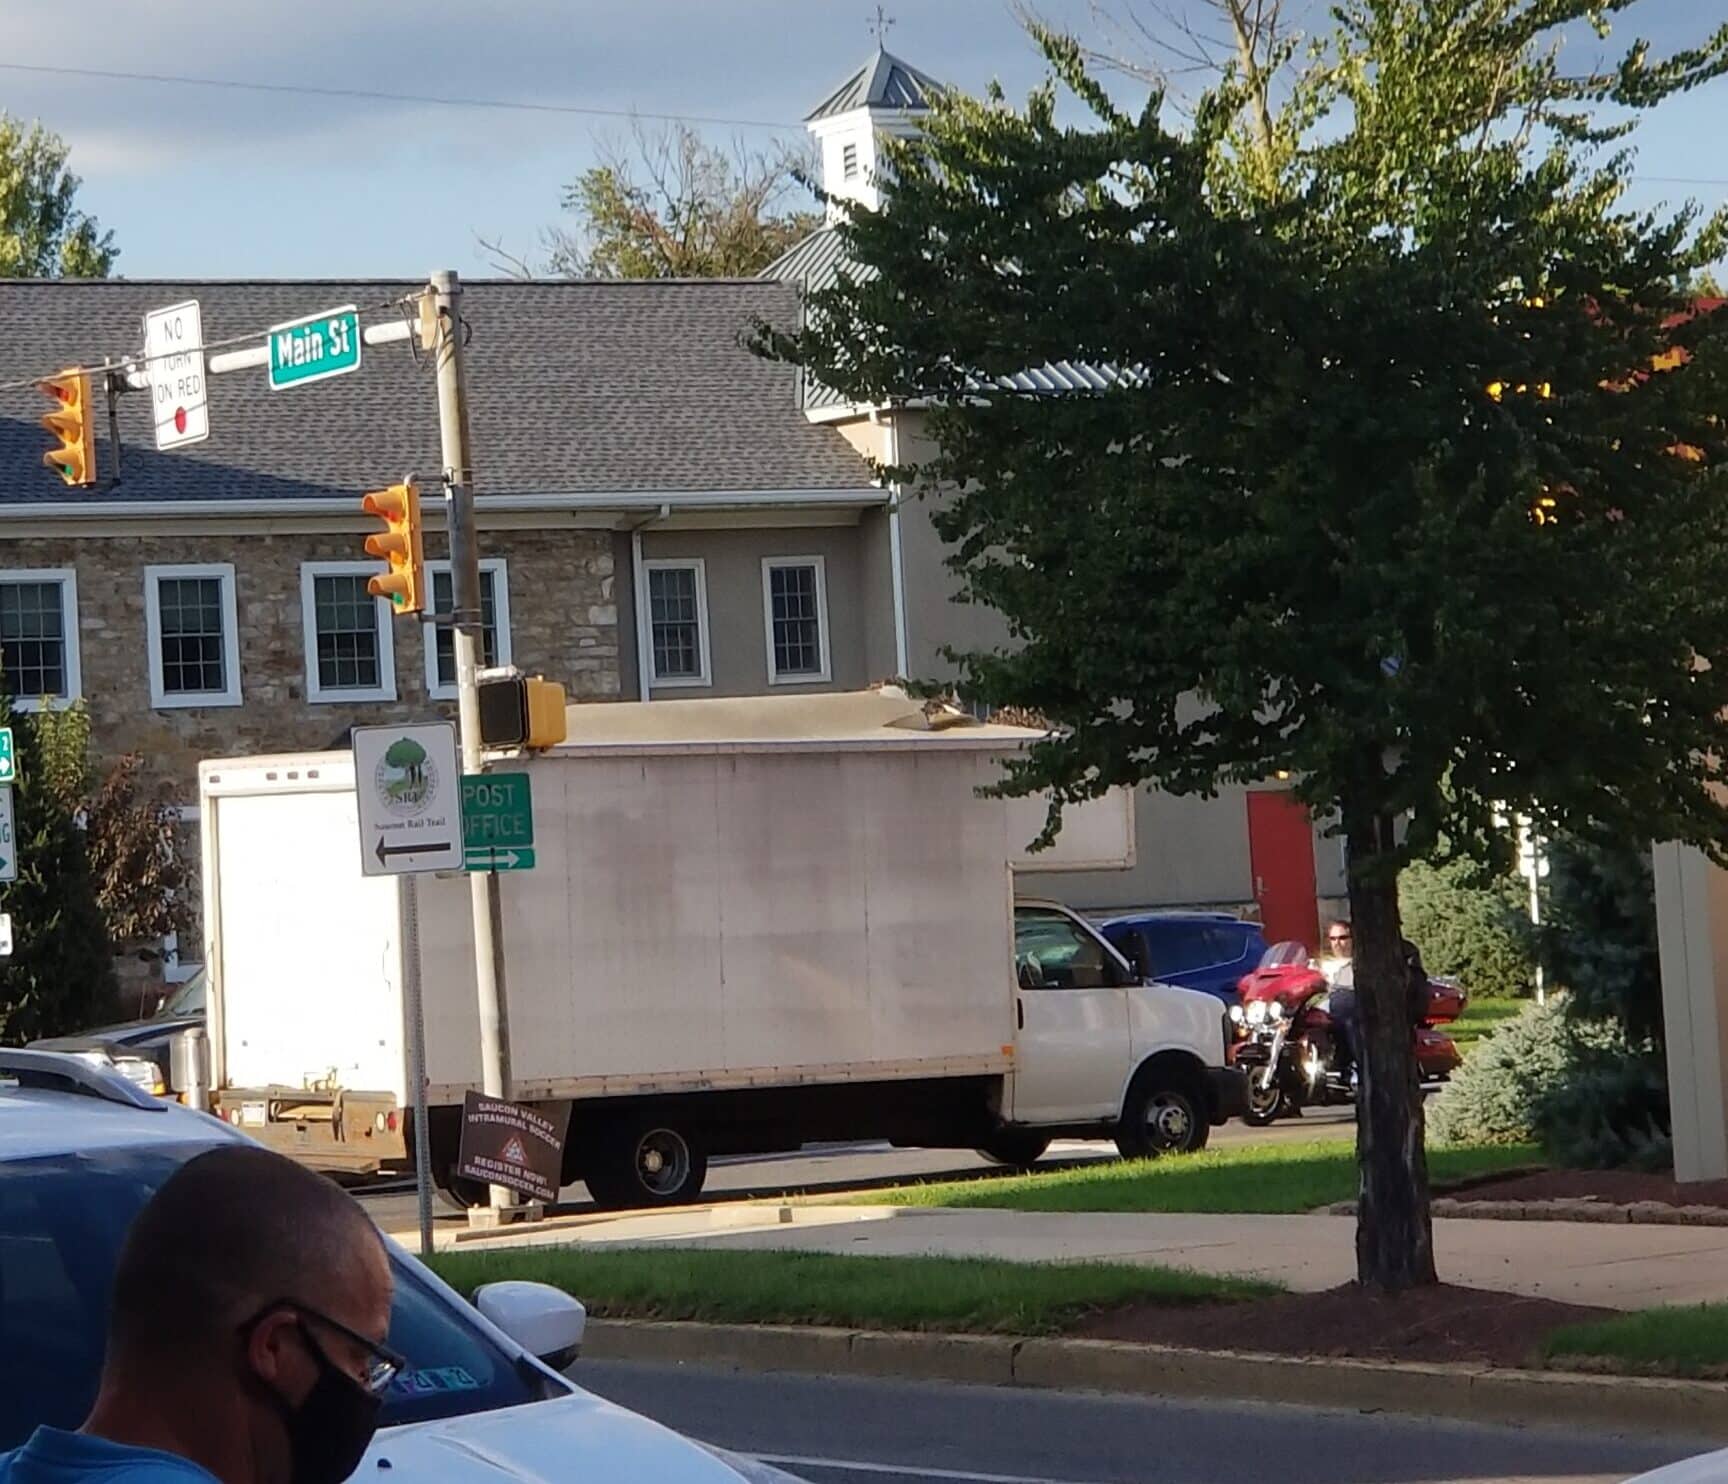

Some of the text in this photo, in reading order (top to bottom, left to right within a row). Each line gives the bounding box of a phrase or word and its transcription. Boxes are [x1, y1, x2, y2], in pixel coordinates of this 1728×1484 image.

[163, 316, 184, 342] NO
[277, 318, 351, 369] Main St
[162, 350, 192, 371] TURN
[157, 374, 200, 404] ON RED
[463, 783, 515, 808] POST
[478, 1103, 554, 1131] SAUCON VALLEY
[468, 1113, 560, 1150] INTRAMURAL SOCCER
[474, 1155, 521, 1174] REGISTER
